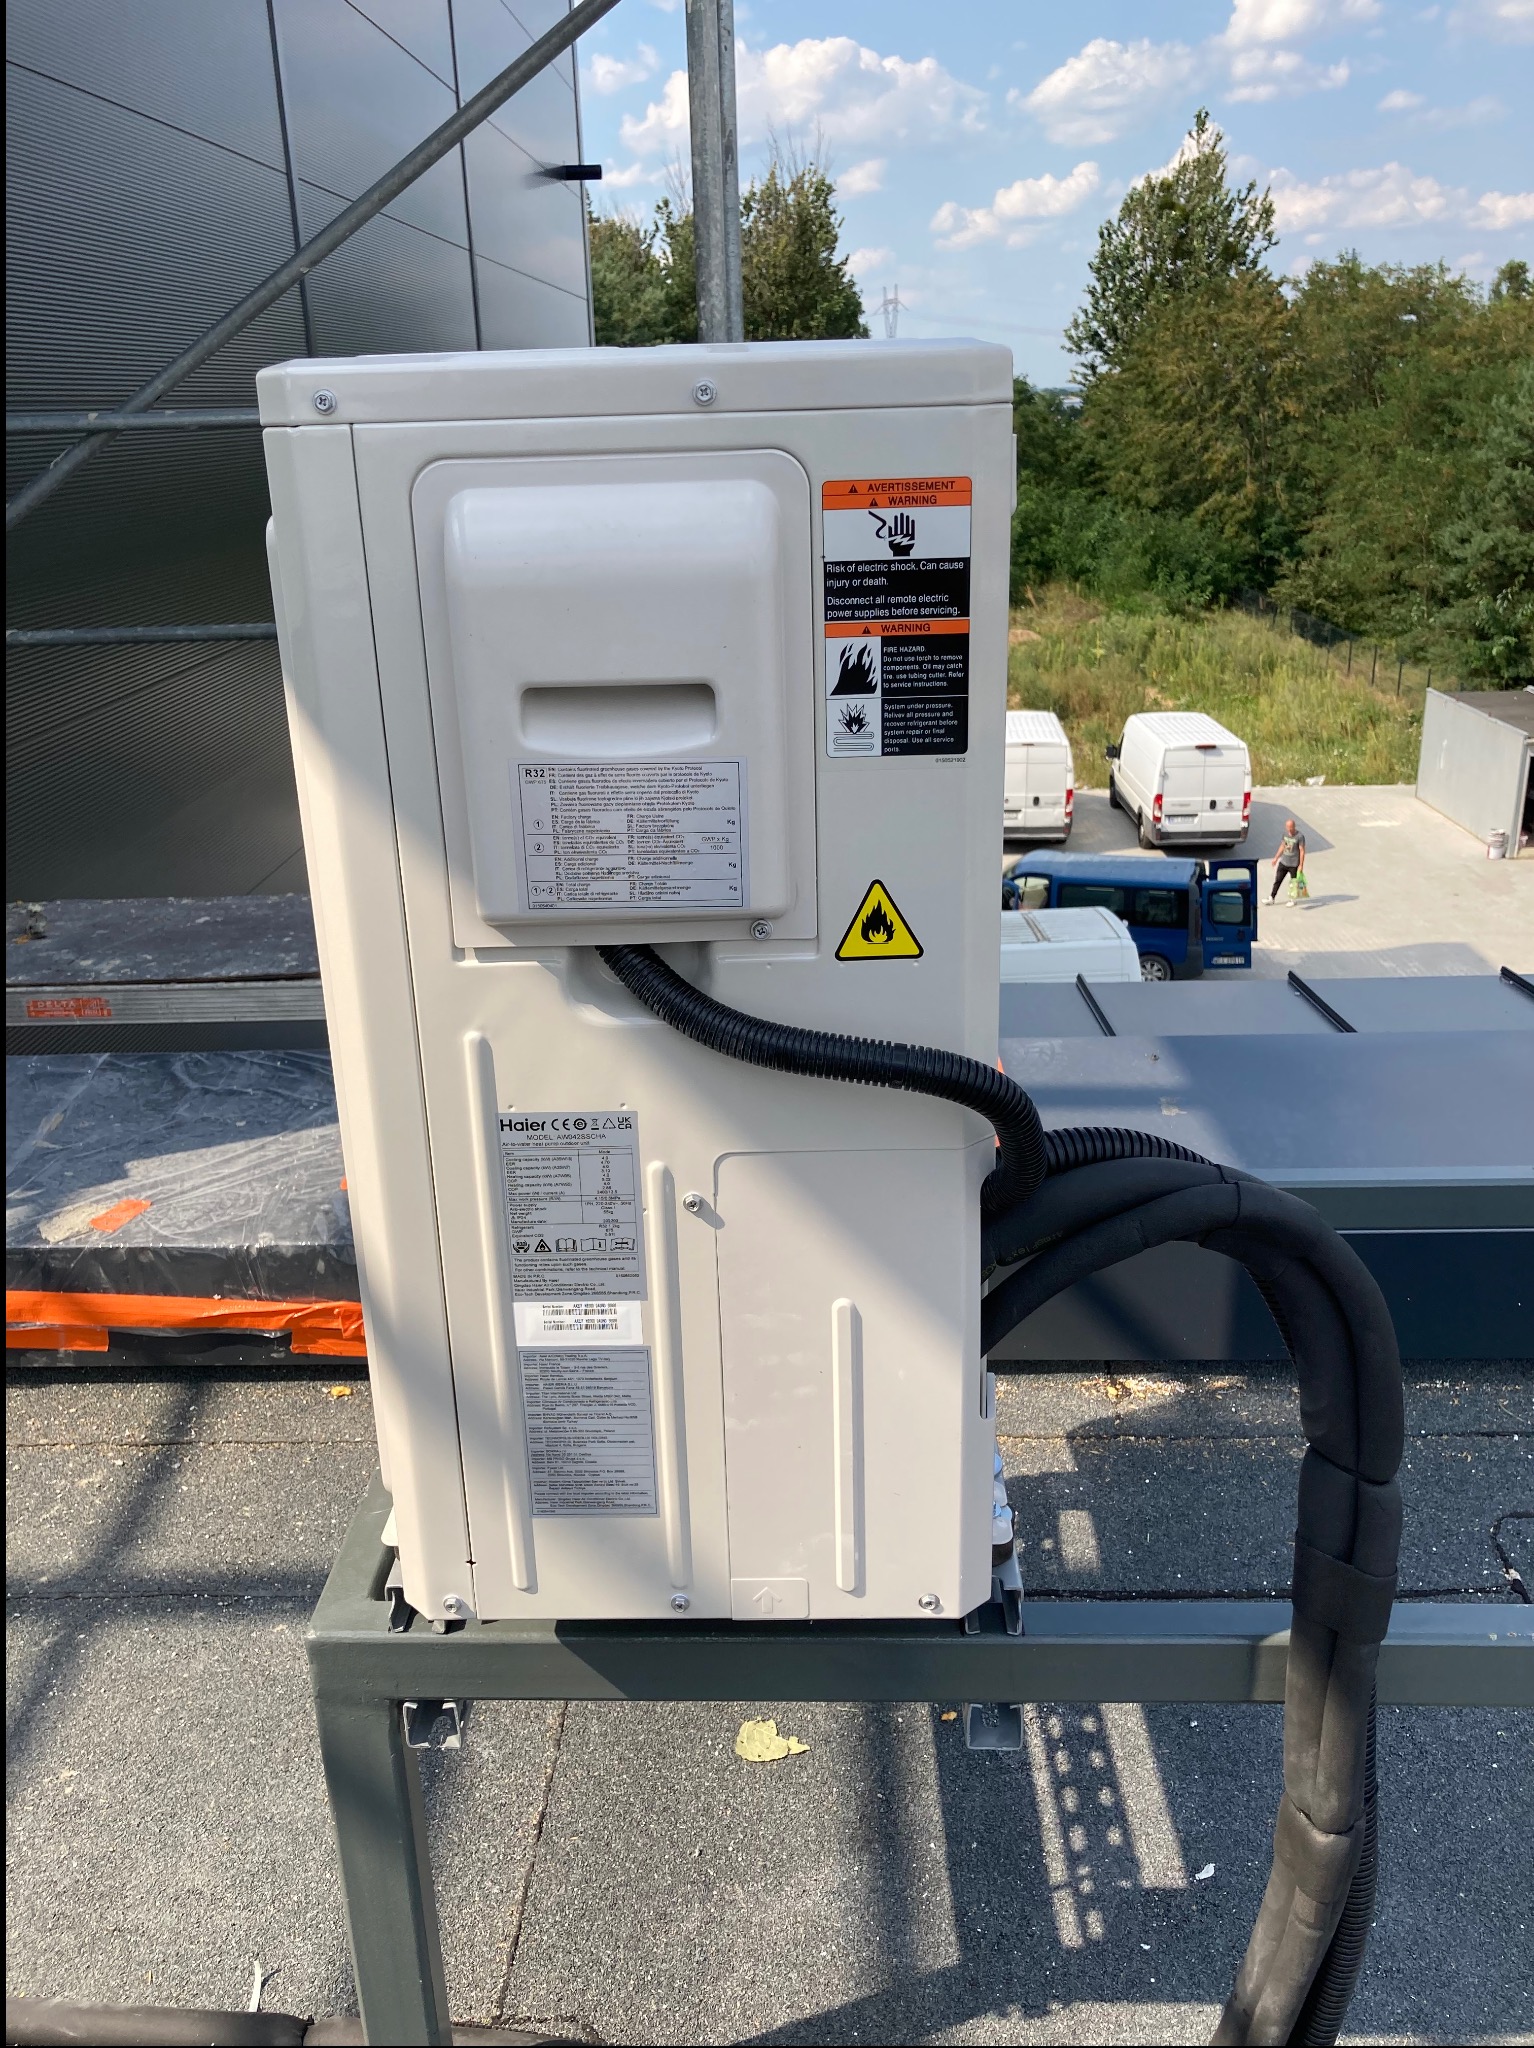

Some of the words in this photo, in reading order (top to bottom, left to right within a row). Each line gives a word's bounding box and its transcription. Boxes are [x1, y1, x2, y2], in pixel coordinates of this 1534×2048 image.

[867, 481, 955, 492] AVERTISSEMENT
[888, 496, 937, 506] WARNING
[826, 564, 845, 573] Risk
[847, 564, 855, 572] of
[858, 563, 888, 572] electric
[891, 562, 918, 571] shock.
[920, 561, 936, 570] Can
[826, 578, 849, 589] injury
[863, 577, 888, 586] death.
[827, 596, 873, 606] Disconnect
[875, 595, 884, 604] all
[888, 594, 916, 604] remote
[918, 593, 949, 603] electric
[827, 610, 852, 619] power
[855, 608, 889, 619] supplies
[892, 607, 918, 616] before
[920, 606, 960, 617] servicing.
[881, 623, 931, 633] WARNING
[525, 769, 545, 777] R32
[500, 1118, 546, 1131] Haier
